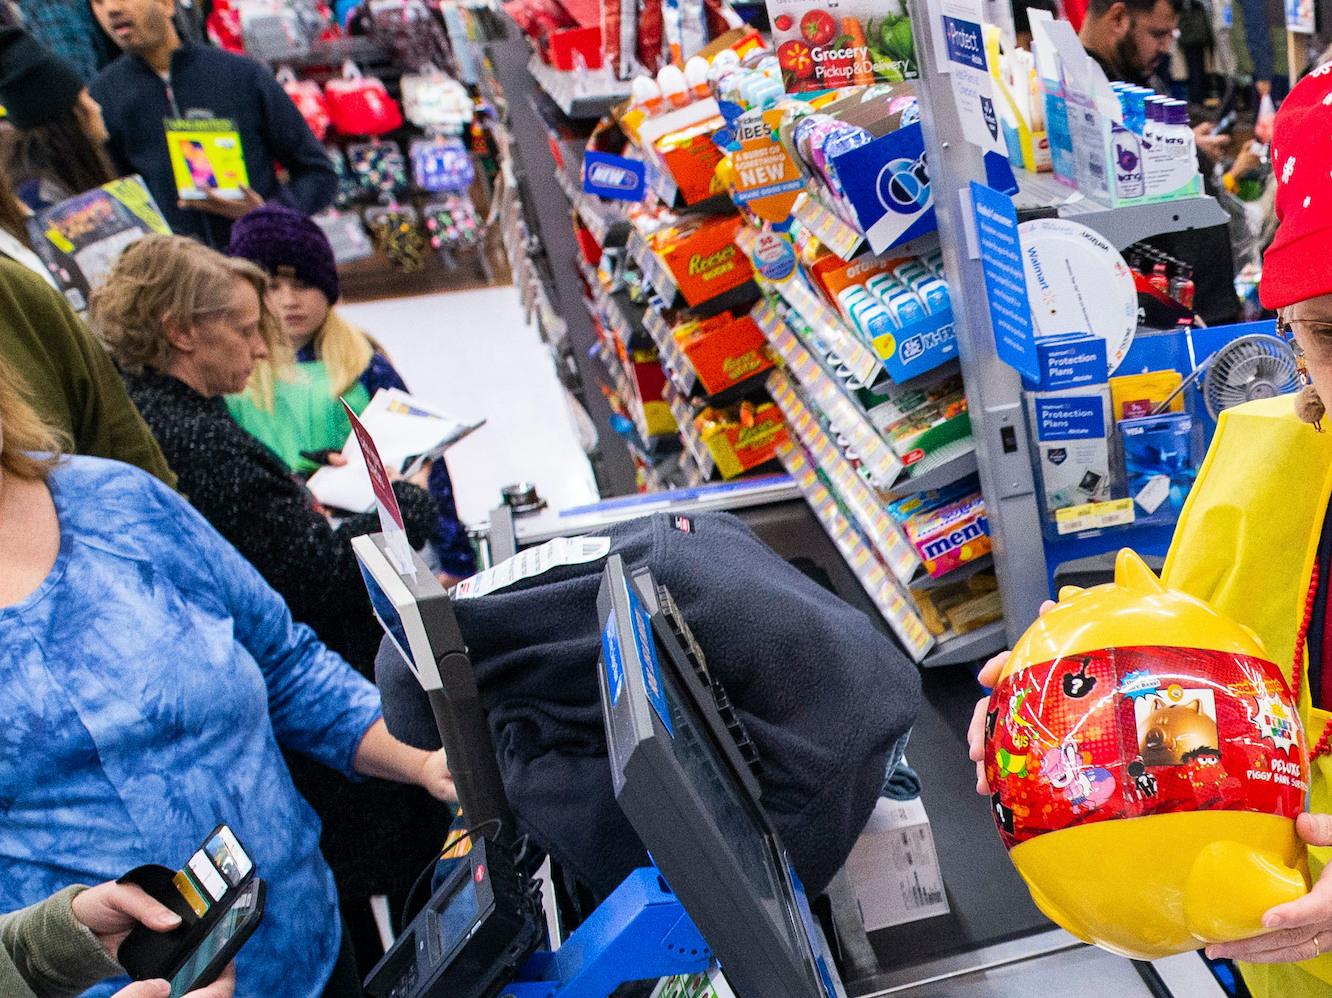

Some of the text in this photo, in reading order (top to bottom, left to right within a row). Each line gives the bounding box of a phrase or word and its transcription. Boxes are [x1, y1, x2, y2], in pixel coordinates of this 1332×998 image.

[811, 46, 868, 62] Grocery
[733, 123, 771, 140] VIBES
[741, 162, 785, 187] NEW
[1027, 246, 1050, 291] Walmart
[1048, 353, 1097, 367] Protection
[1049, 366, 1075, 378] Plans
[1042, 409, 1094, 421] Protection
[1042, 419, 1069, 429] Plans
[1125, 427, 1144, 436] VISA
[925, 515, 987, 560] ment
[1011, 735, 1029, 748] GUS
[1271, 759, 1301, 777] DELUXE
[1247, 770, 1271, 782] PIGGY
